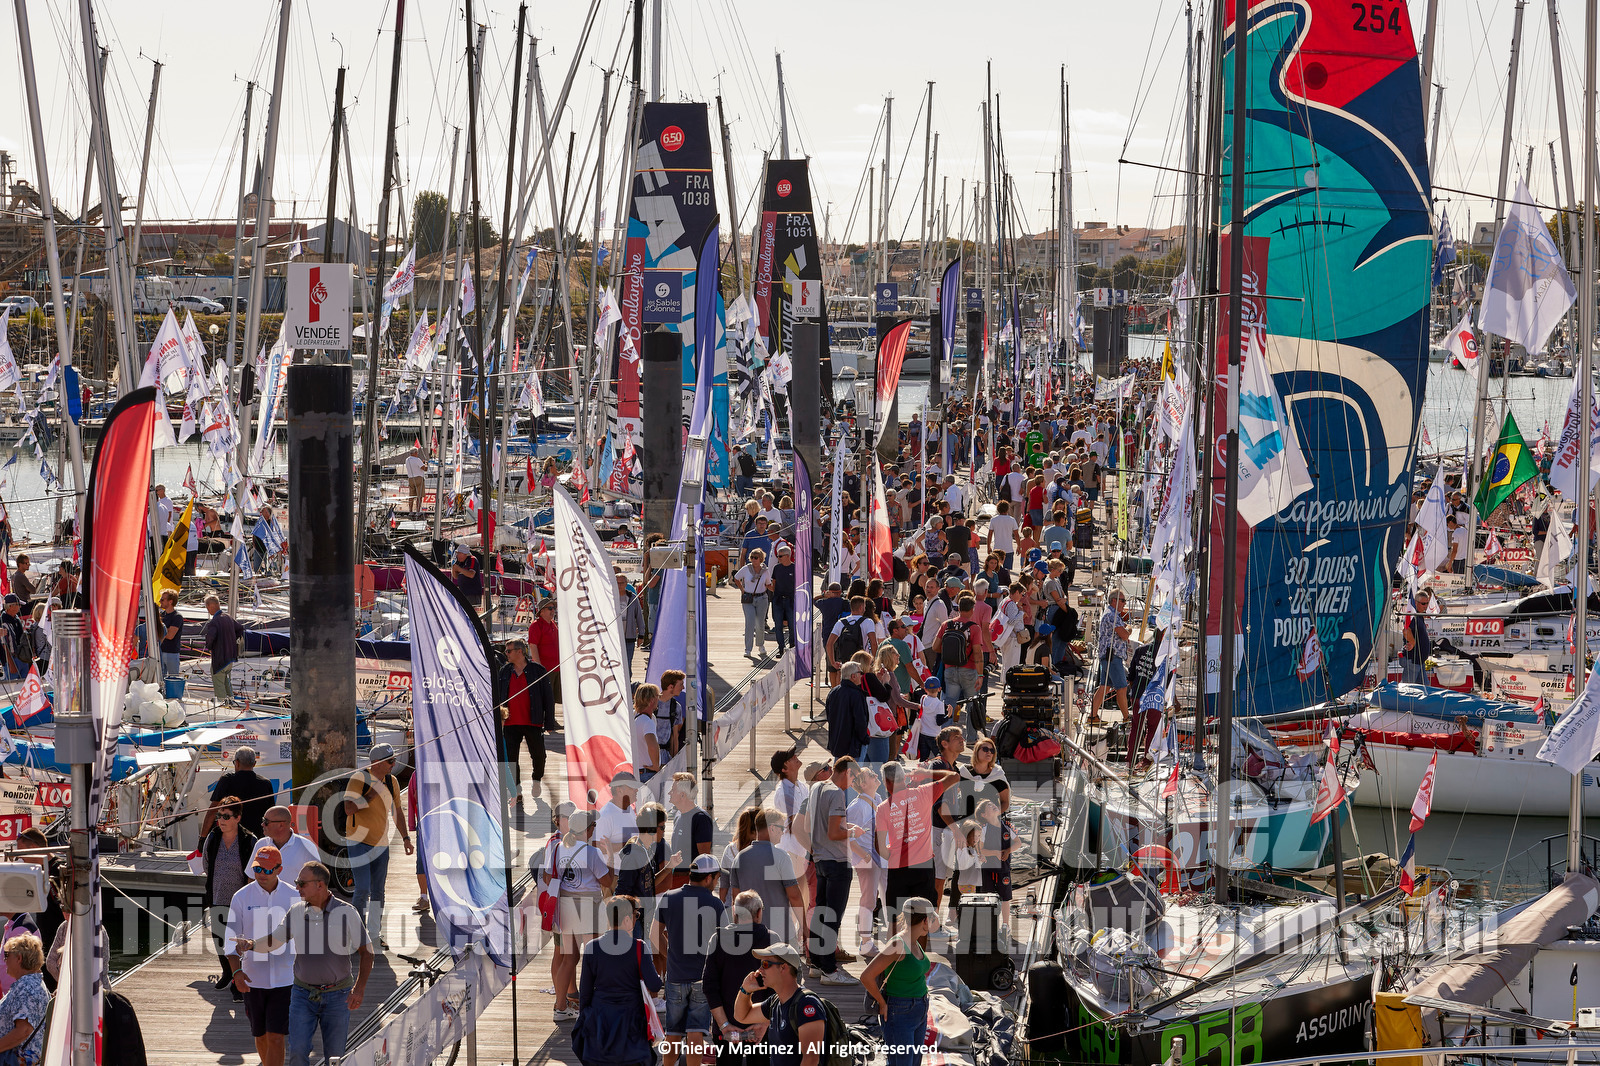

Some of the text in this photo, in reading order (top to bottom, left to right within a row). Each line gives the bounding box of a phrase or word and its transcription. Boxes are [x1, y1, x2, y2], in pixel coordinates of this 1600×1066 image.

[1352, 3, 1402, 35] 254
[686, 175, 710, 189] FRA
[681, 191, 710, 206] 1038
[786, 215, 811, 226] FRA
[786, 227, 812, 238] 1051
[759, 222, 775, 285] Boulangère
[655, 298, 681, 306] Sables
[295, 325, 340, 339] VENDÉE
[1284, 554, 1358, 585] 30 JOURS
[1290, 586, 1352, 615] DE MER
[1469, 621, 1500, 633] 1040
[1480, 639, 1500, 647] FRA
[358, 675, 412, 687] LIARDET 90
[3, 786, 72, 804] RONDON 100
